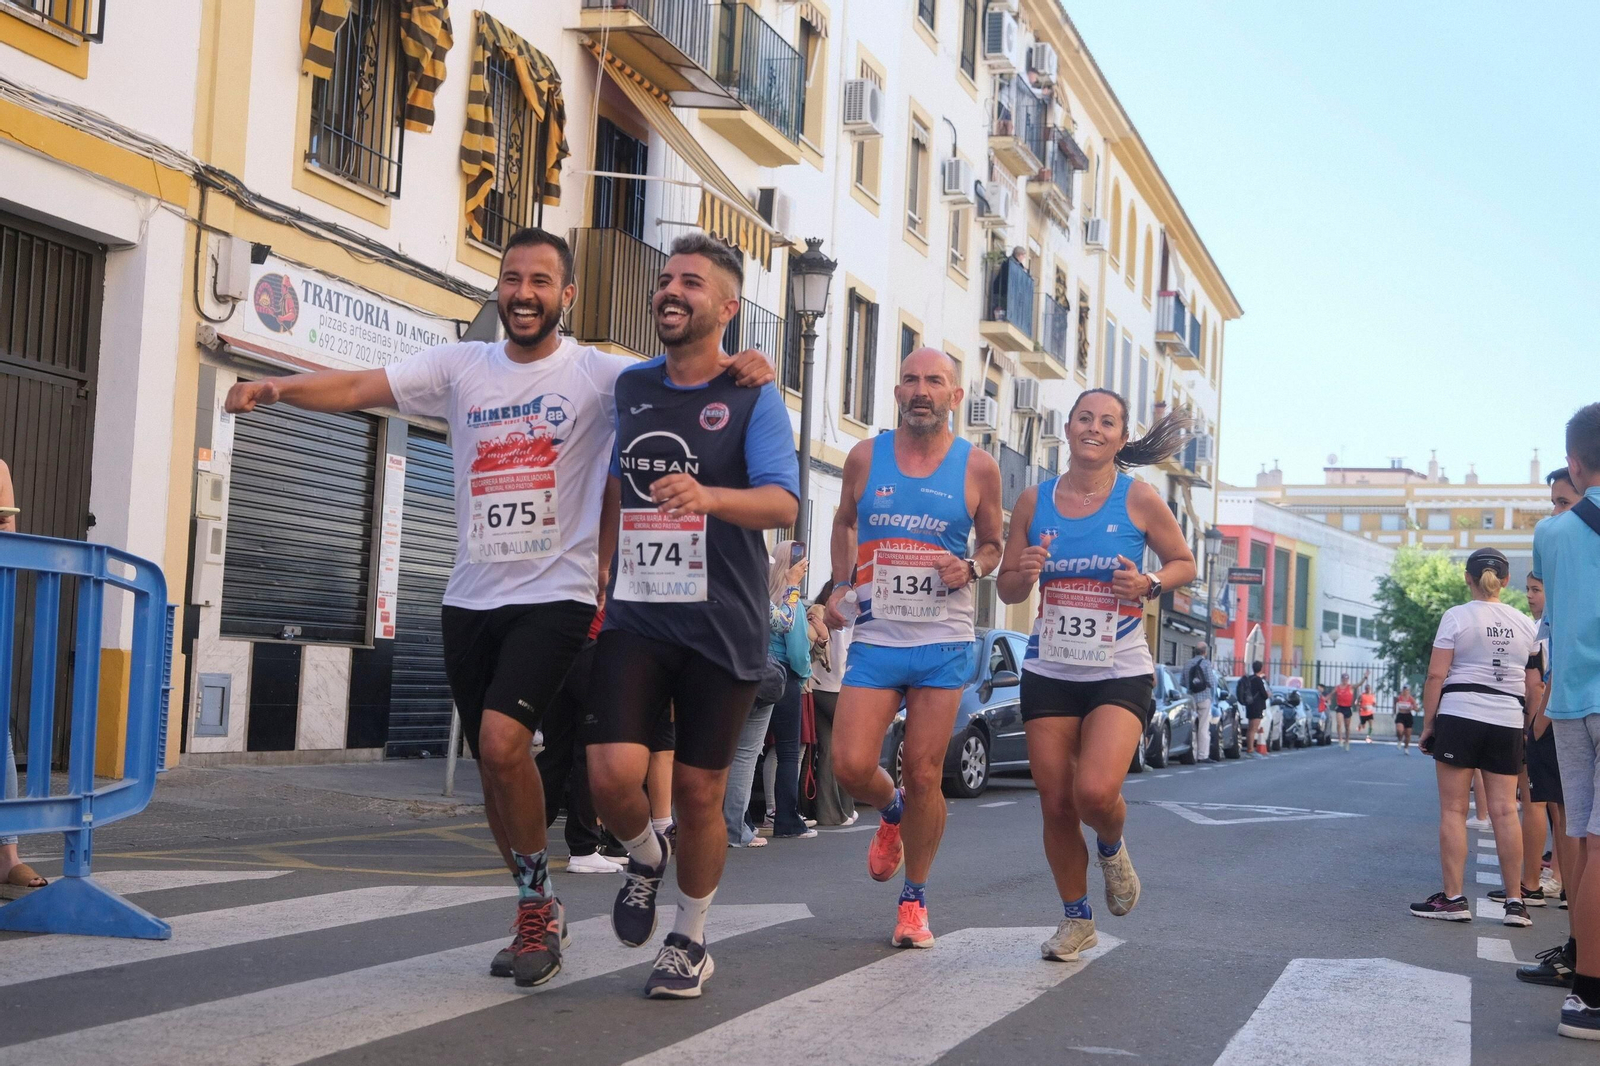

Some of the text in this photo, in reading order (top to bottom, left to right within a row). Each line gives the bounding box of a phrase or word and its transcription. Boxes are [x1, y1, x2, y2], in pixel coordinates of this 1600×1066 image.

[301, 279, 390, 332] TRATTORIA
[396, 320, 407, 338] DI
[319, 311, 425, 356] pizzas artesanas y bocat
[318, 333, 335, 352] 692
[337, 338, 354, 356] 237
[466, 402, 542, 425] PRIMEROS
[547, 410, 564, 421] 22
[487, 446, 532, 459] mundial
[498, 454, 548, 465] de tu vida
[620, 456, 699, 475] NISSAN
[487, 501, 537, 529] 675
[868, 513, 949, 533] enerplus
[636, 542, 682, 566] 174
[879, 540, 935, 551] Marató
[1040, 555, 1121, 573] nerplus
[892, 575, 932, 595] 134
[1057, 615, 1097, 638] 133
[1504, 628, 1514, 638] 21
